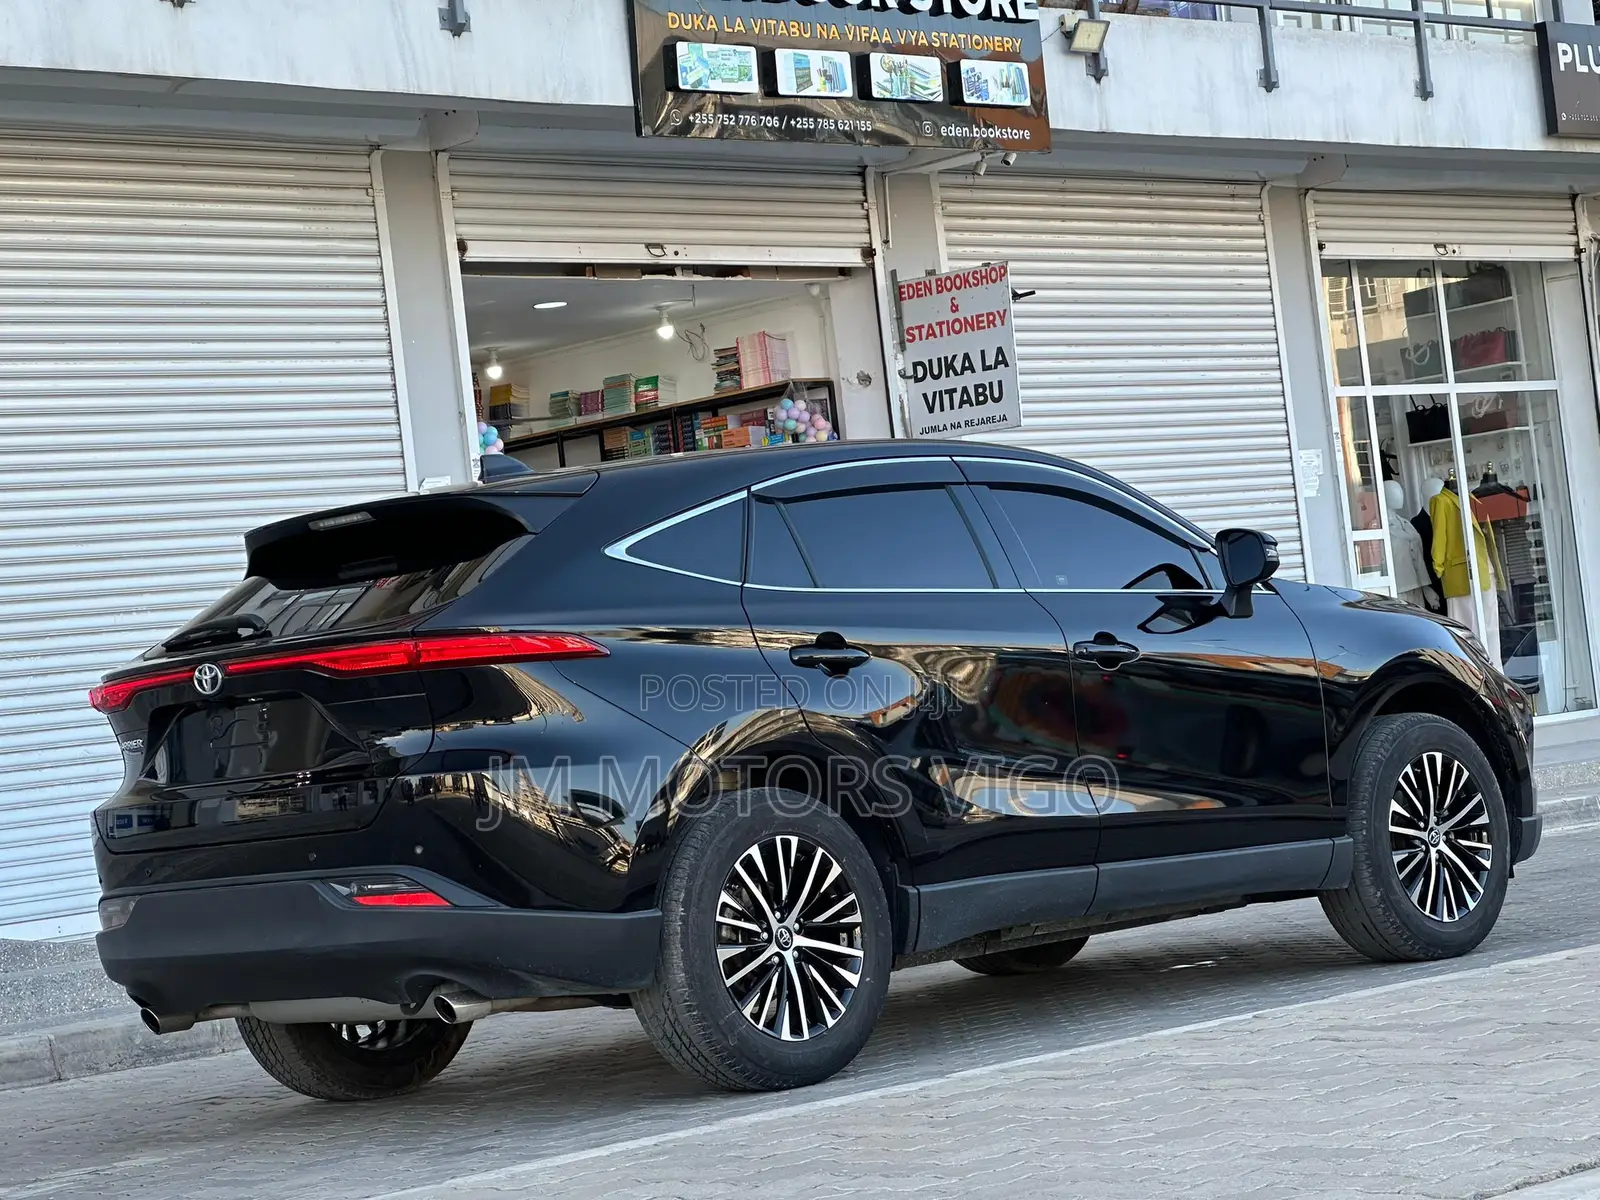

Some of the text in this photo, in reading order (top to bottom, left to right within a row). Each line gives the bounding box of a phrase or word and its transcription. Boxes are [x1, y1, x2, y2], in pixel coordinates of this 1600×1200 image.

[667, 11, 1023, 53] DUKA LA VITABU NA VIFAA VYA STATIONERY
[688, 113, 872, 132] +255 752 776 706 / +255 785 621 155
[940, 124, 1031, 139] eden.bookstore
[898, 264, 1008, 302] EDEN BOOKSHOP
[950, 296, 959, 313] &
[905, 309, 1007, 344] STATIONERY
[912, 346, 1010, 384] DUKA LA
[922, 379, 1004, 414] VITABU
[919, 413, 1008, 436] JUMLA NA REJAREJA
